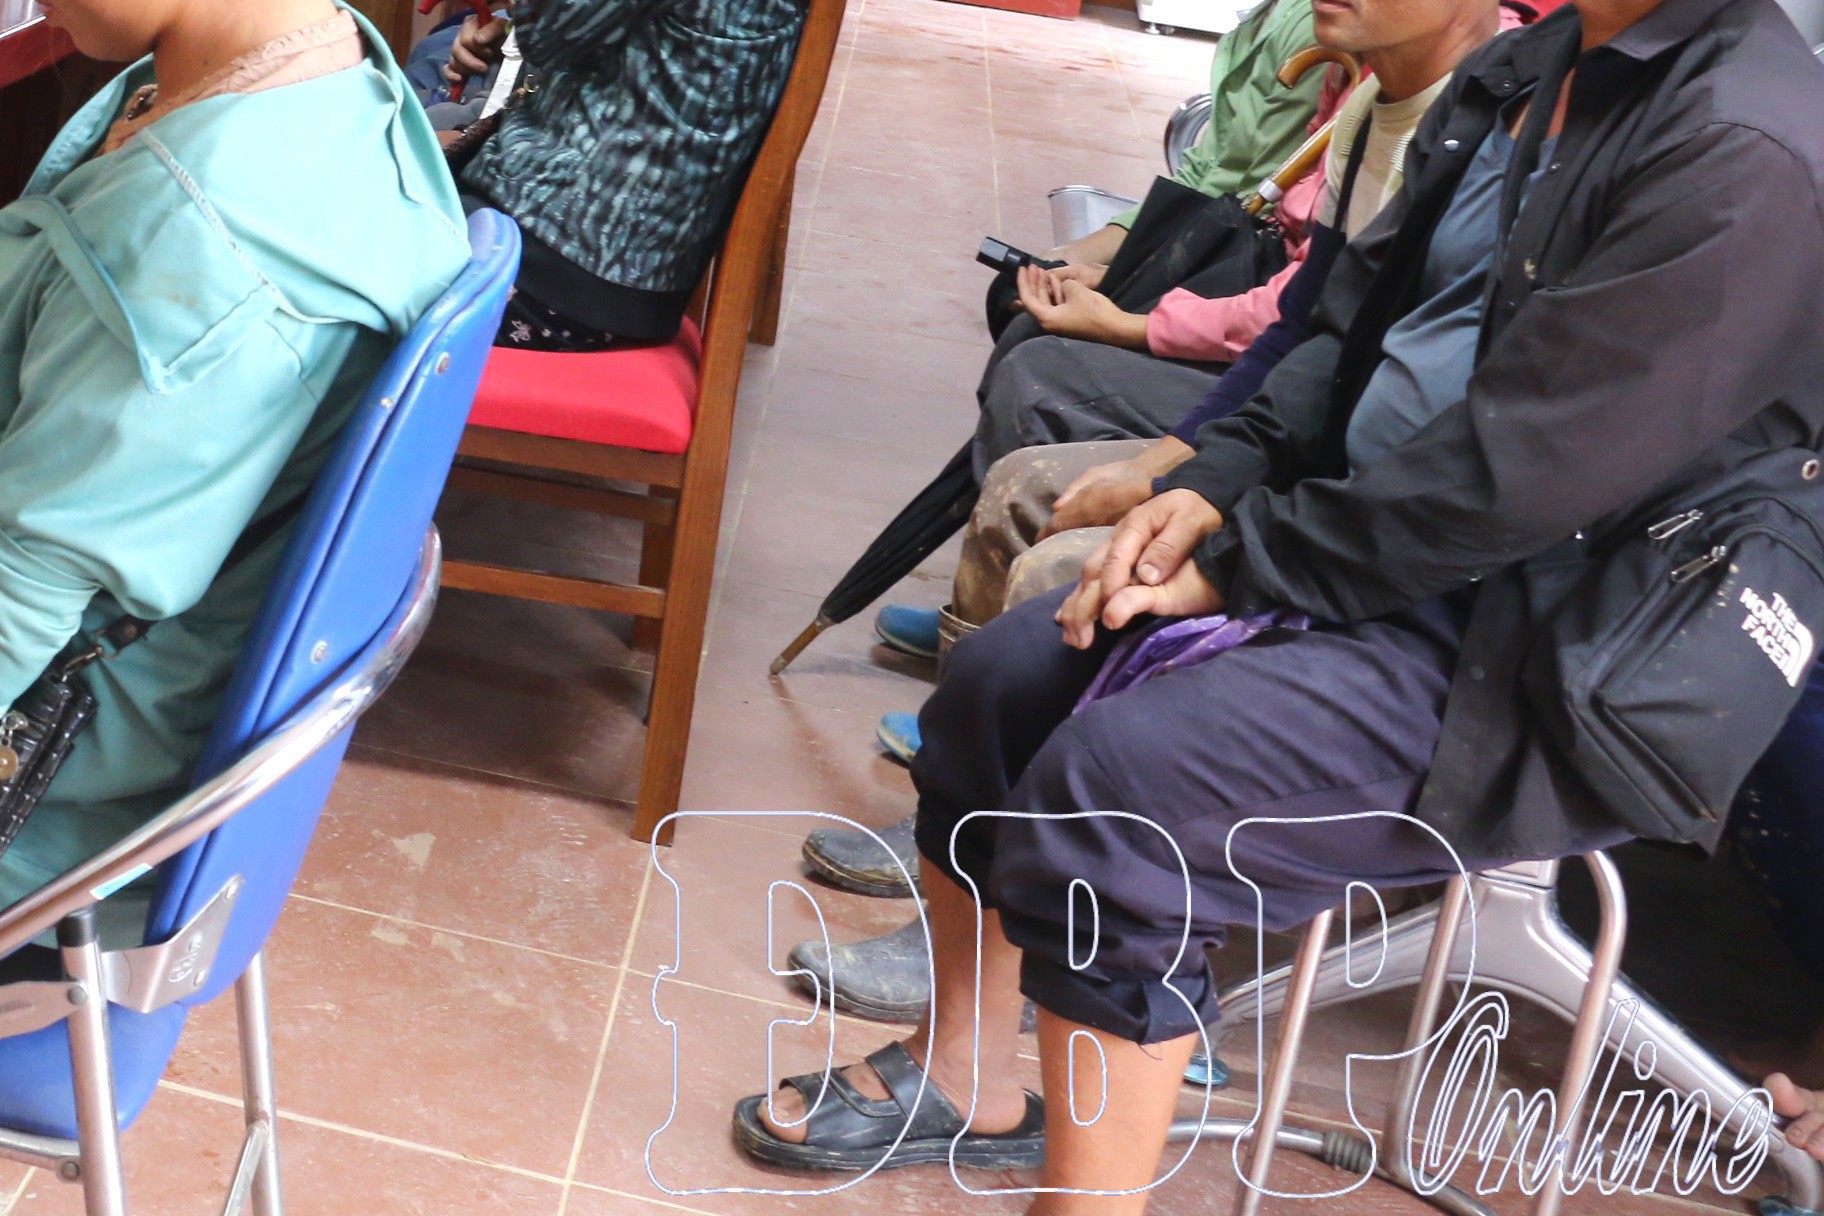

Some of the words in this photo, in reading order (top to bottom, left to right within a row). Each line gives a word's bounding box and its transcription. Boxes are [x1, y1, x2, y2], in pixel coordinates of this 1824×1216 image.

[1739, 587, 1793, 650] NORTH
[1771, 591, 1798, 632] THE
[1741, 613, 1789, 672] FACE
